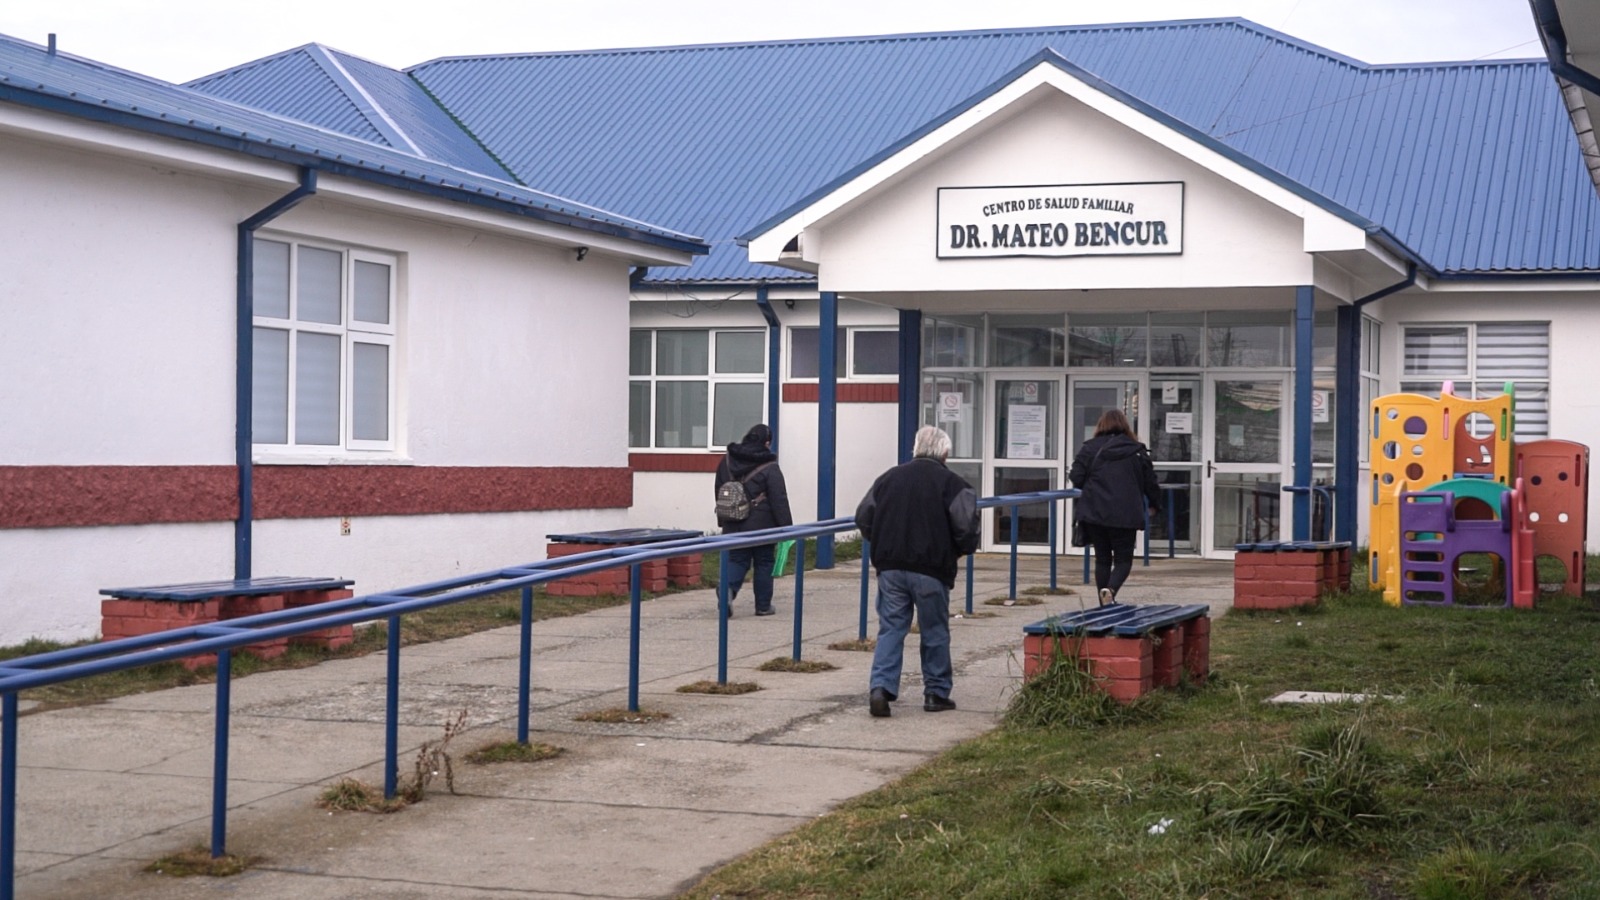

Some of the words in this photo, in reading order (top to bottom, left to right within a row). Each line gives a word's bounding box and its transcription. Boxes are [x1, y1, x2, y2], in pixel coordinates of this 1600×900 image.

[983, 199, 1026, 217] CENTRO
[1028, 199, 1043, 211] DE
[1044, 197, 1080, 210] SALUD
[1082, 197, 1134, 215] FAMILIAR
[950, 224, 988, 249] DR.
[992, 222, 1069, 248] MATEO
[1074, 220, 1168, 247] BENCUR
